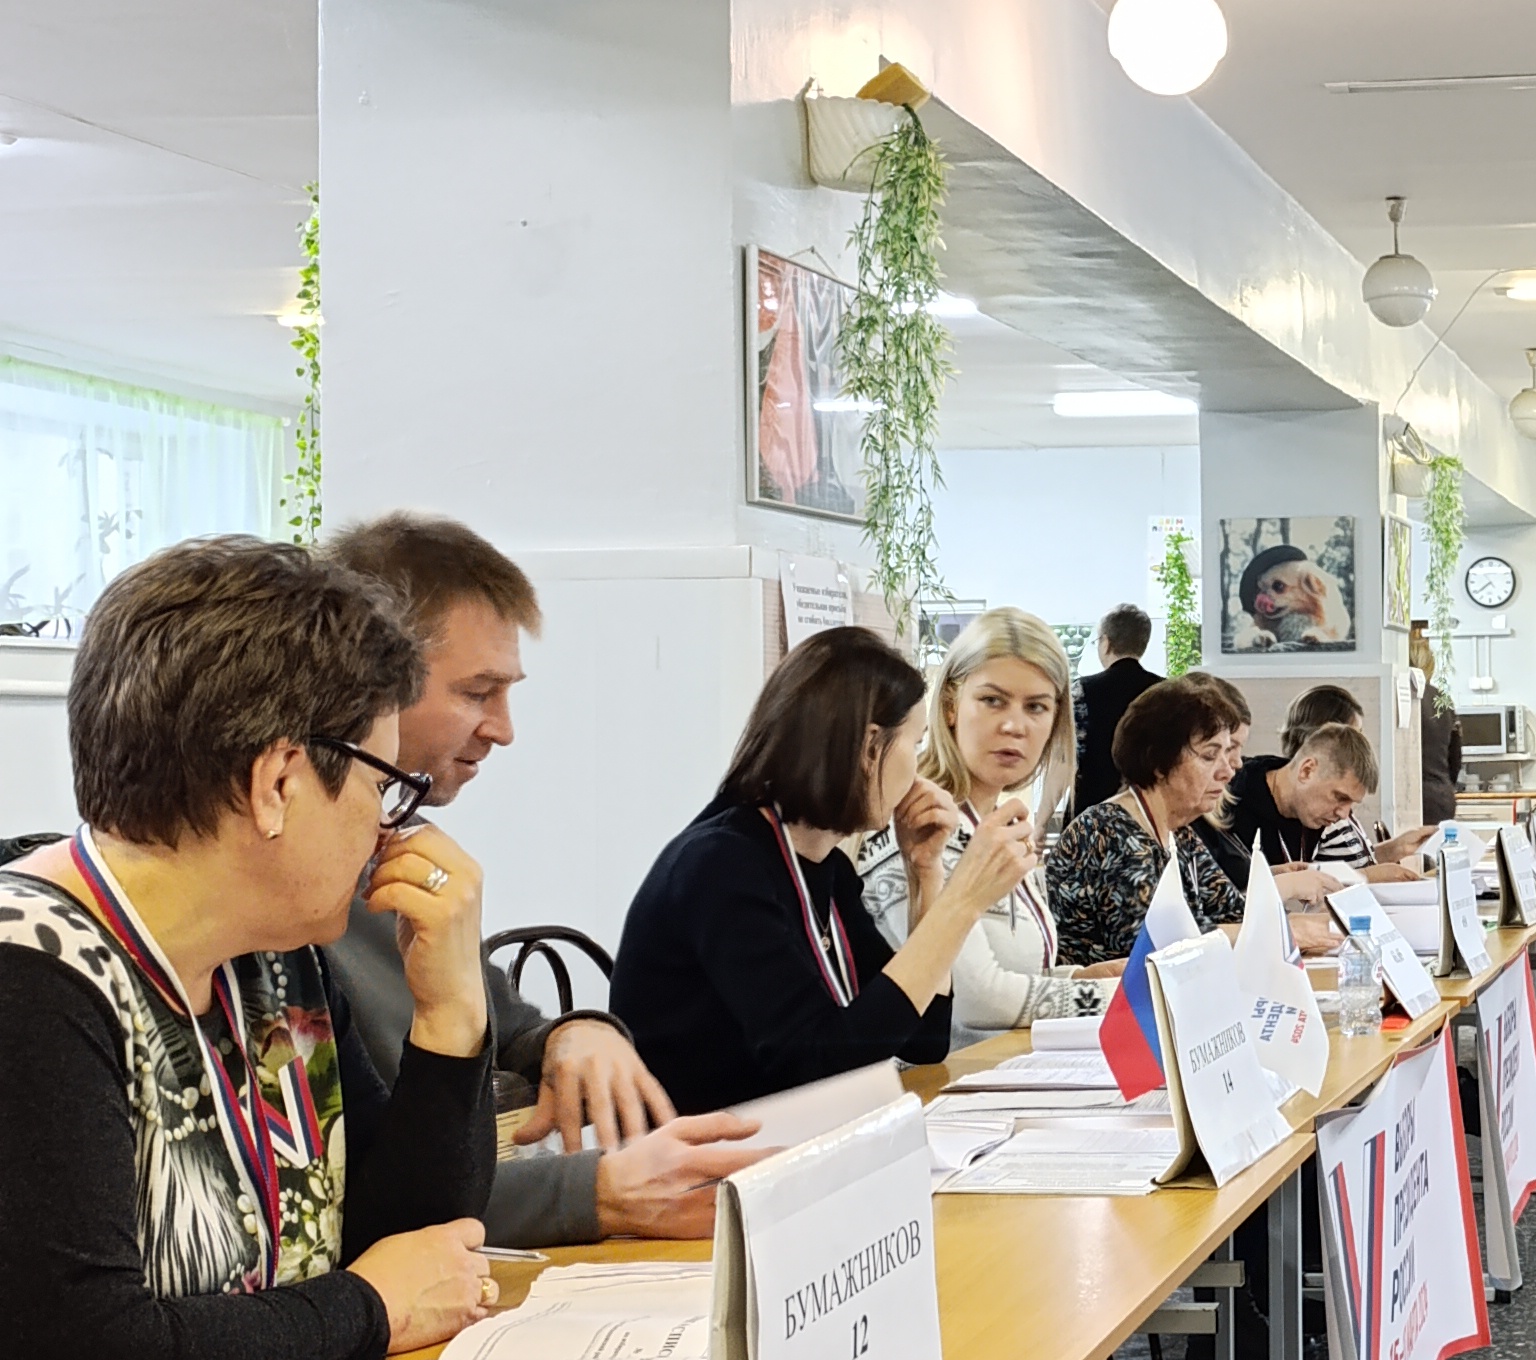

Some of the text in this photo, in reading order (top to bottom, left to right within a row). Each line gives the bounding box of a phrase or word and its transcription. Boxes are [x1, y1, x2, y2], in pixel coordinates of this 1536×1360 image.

[1188, 1021, 1247, 1074] БУМАЖНИКОВ
[1222, 1069, 1234, 1094] 14
[784, 1219, 922, 1341] БУМАЖНИКОВ
